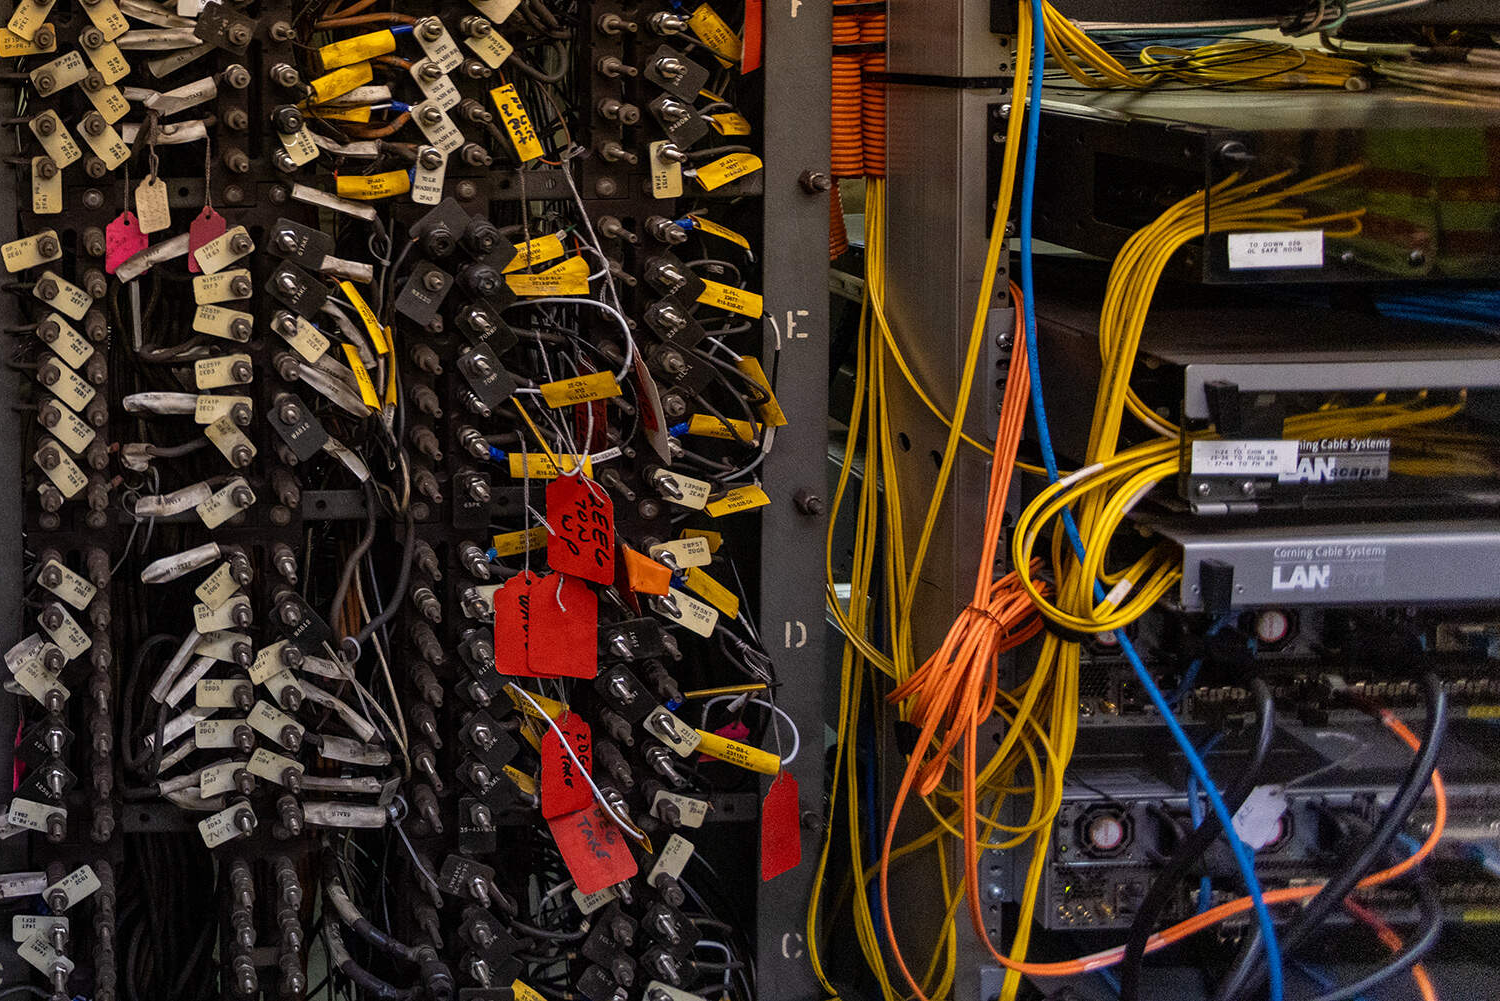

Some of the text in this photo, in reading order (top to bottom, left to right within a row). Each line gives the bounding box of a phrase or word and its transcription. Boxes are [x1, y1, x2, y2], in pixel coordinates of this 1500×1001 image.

[787, 310, 809, 338] E
[1321, 438, 1391, 453] Cable Systems
[575, 501, 590, 542] 70N
[560, 515, 579, 556] WP
[1274, 545, 1387, 559] Corning Cable Systems
[785, 621, 806, 648] D
[782, 933, 802, 958] C
